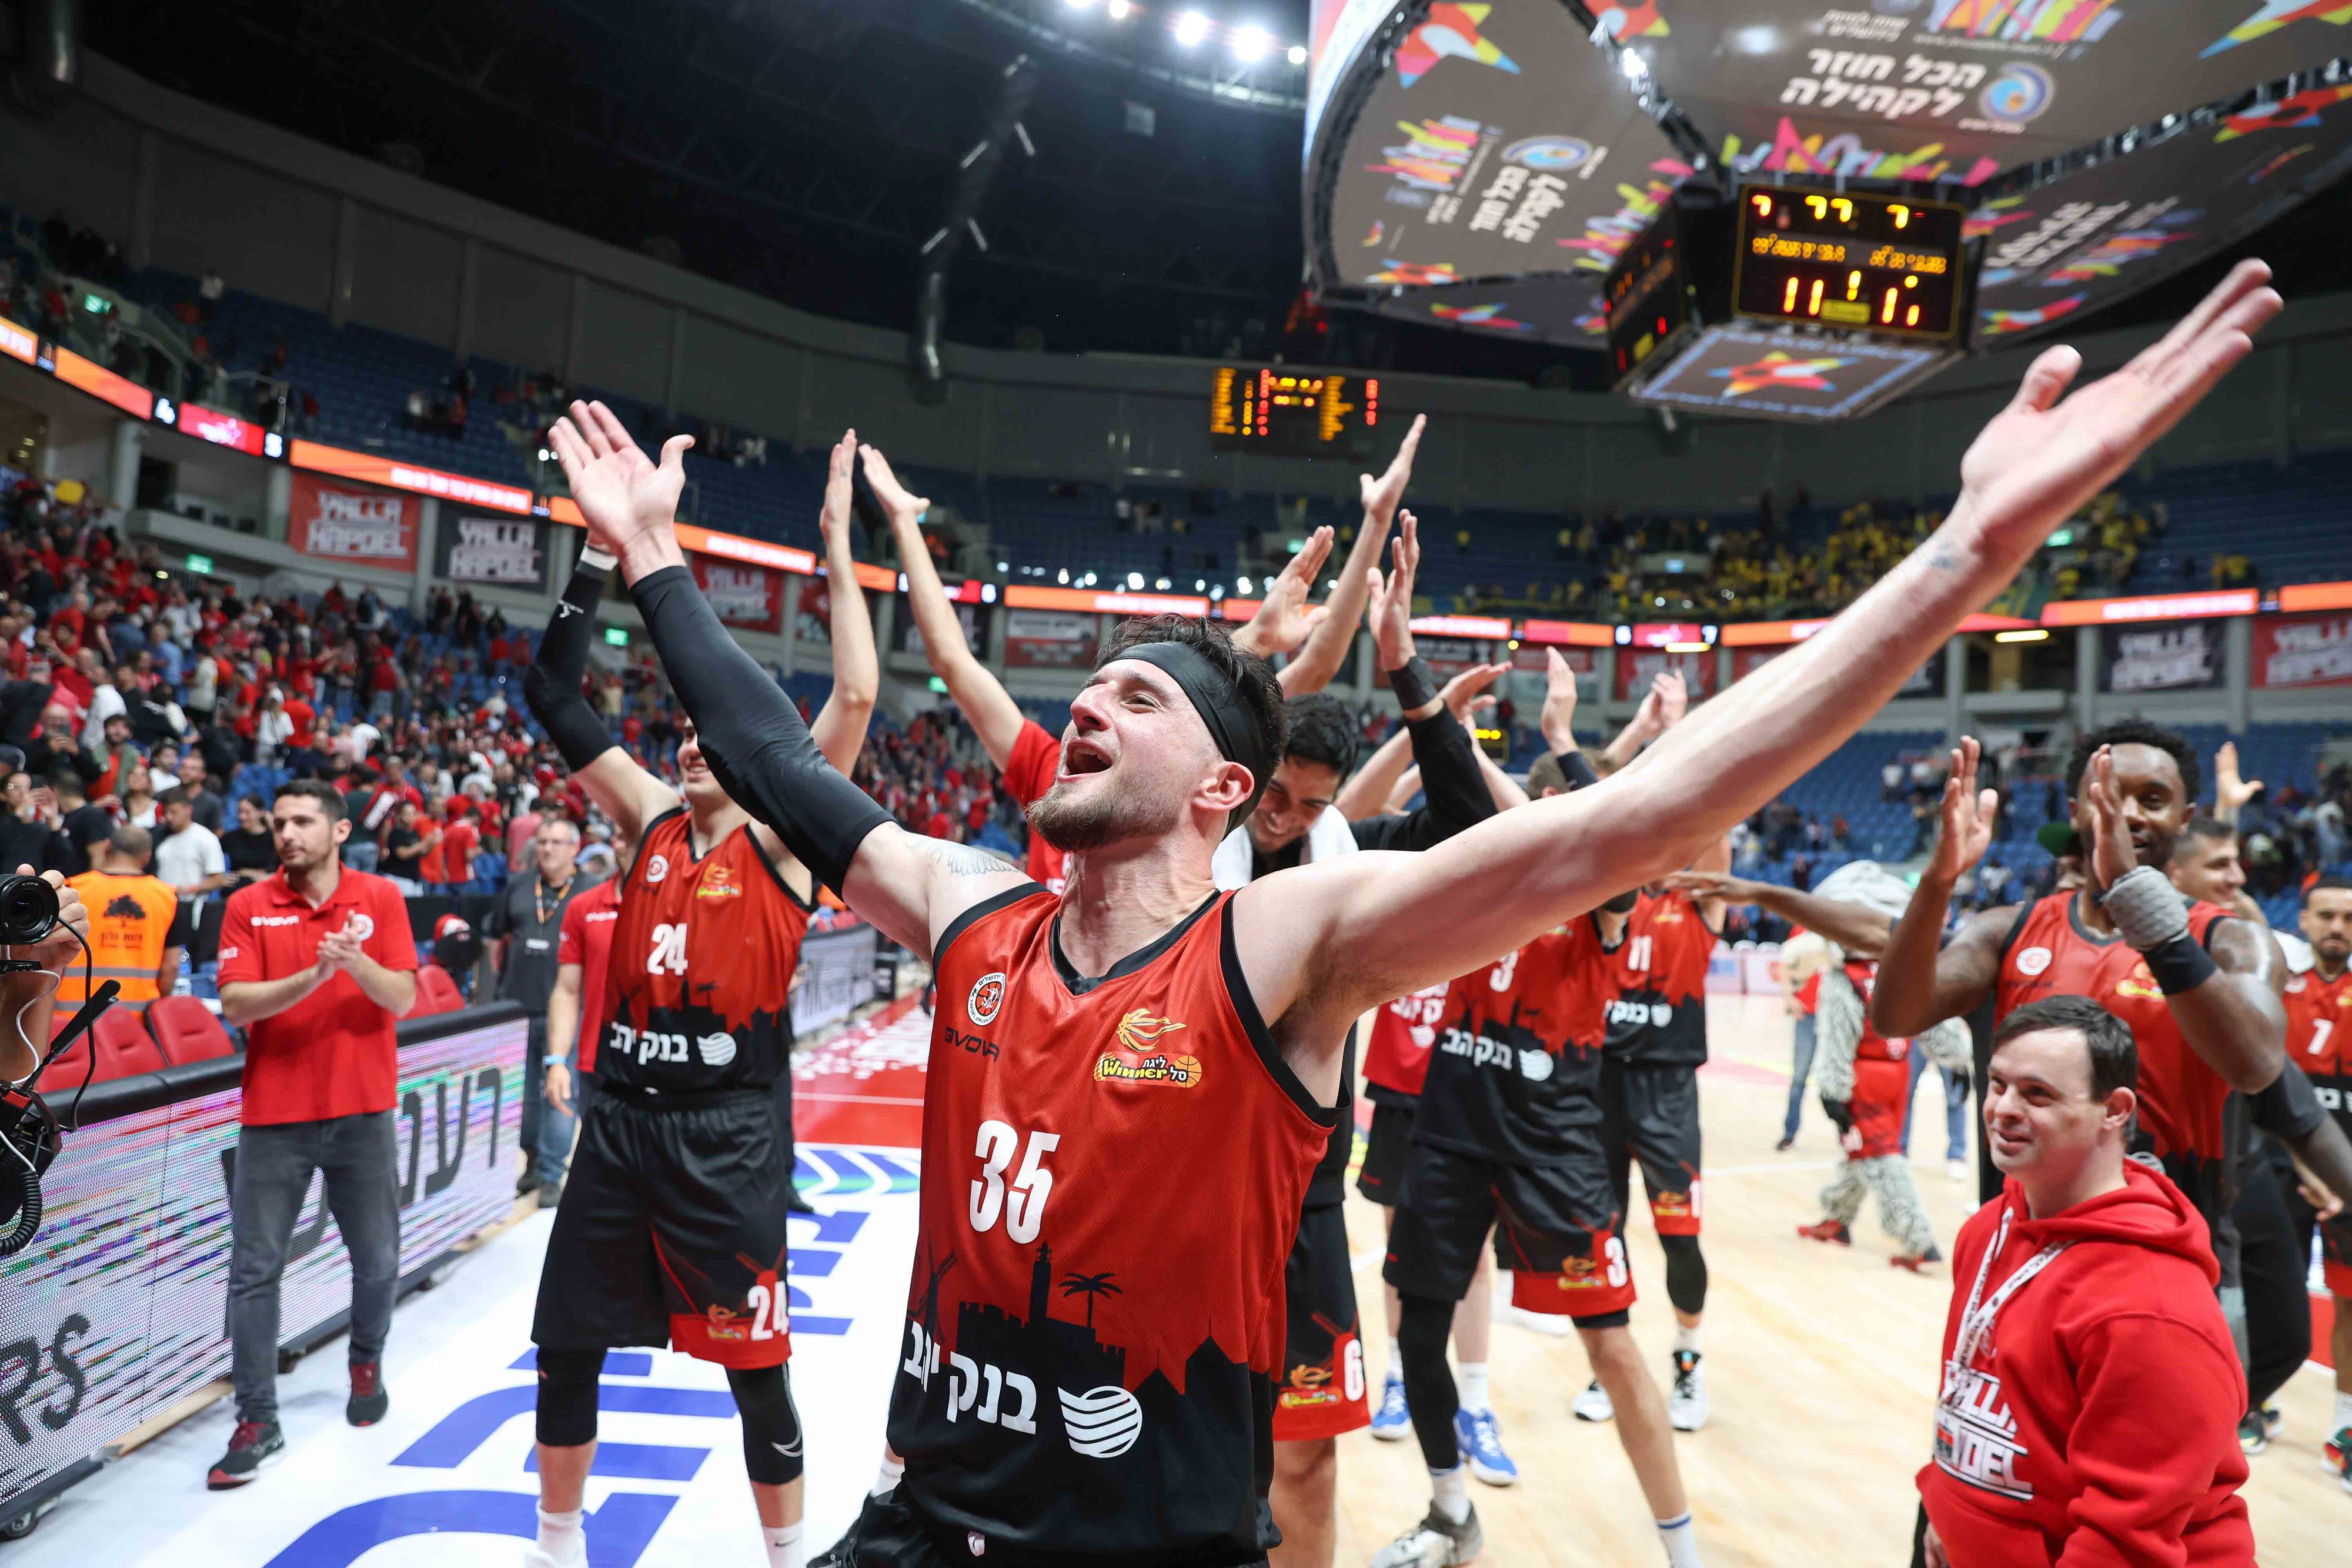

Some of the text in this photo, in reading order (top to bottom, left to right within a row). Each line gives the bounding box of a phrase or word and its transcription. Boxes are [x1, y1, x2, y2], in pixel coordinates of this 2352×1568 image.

[1809, 48, 1987, 89] הכל חוזר
[1780, 76, 1965, 119] לקהילה
[319, 490, 403, 525] YALLA
[647, 922, 689, 976] 24
[1628, 934, 1652, 972] 11
[637, 1030, 689, 1065] בנק
[1142, 1055, 1167, 1068] ליגת
[1169, 1066, 1187, 1081] סל
[970, 1119, 1061, 1245] 35
[1604, 1236, 1628, 1288] 3
[747, 1281, 790, 1342] 24
[1343, 1338, 1365, 1402] 6
[946, 1350, 1037, 1436] בנק
